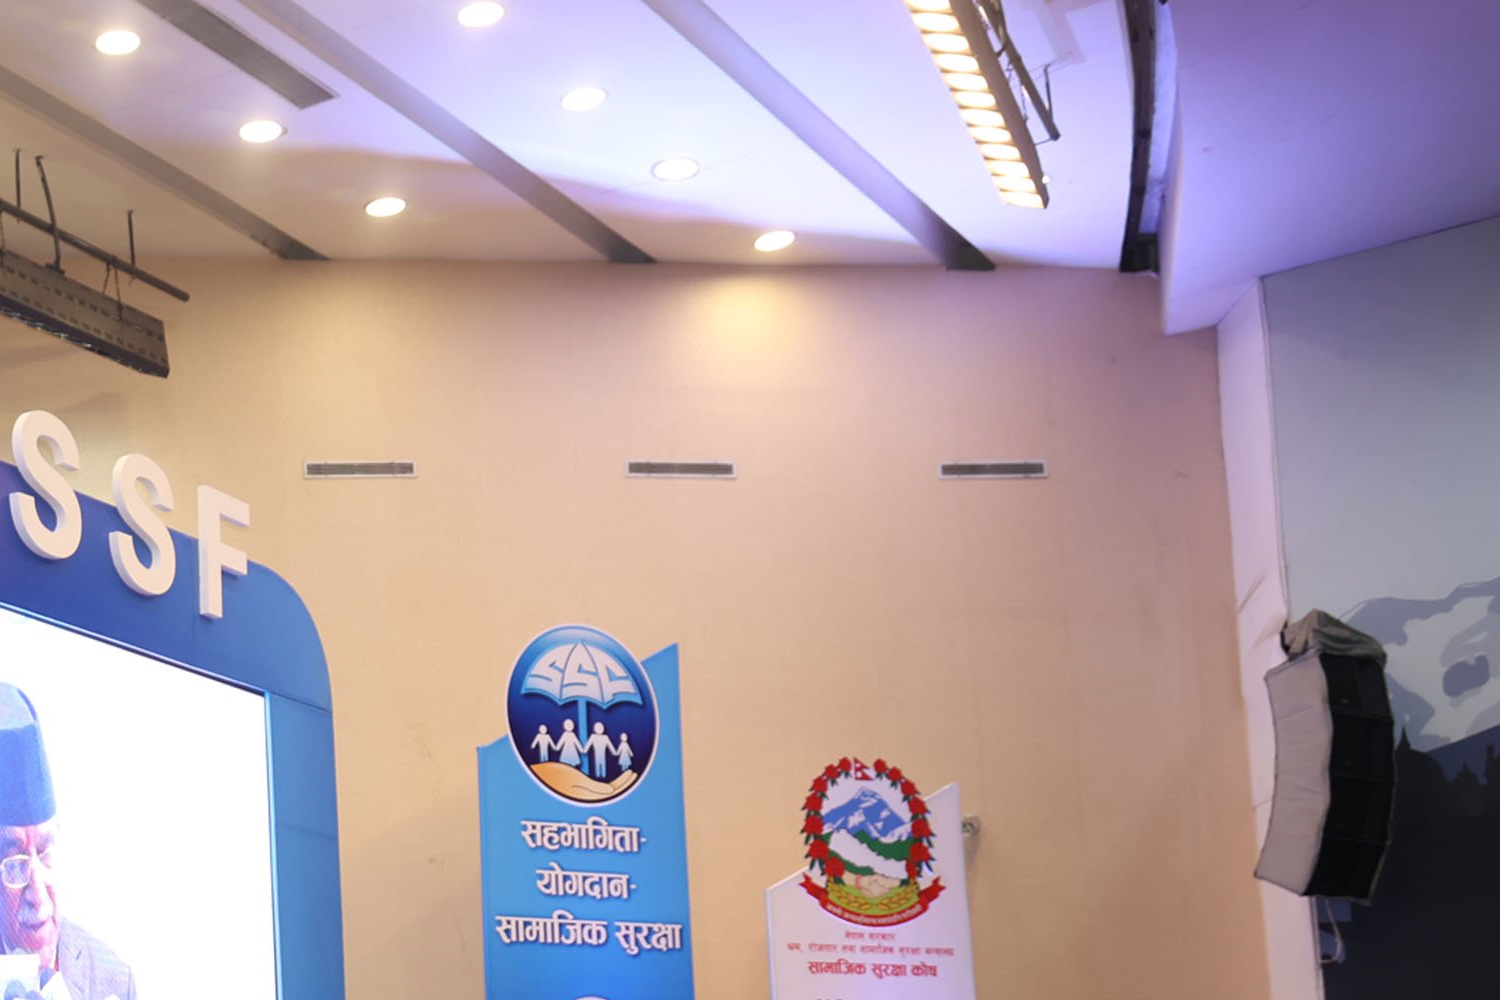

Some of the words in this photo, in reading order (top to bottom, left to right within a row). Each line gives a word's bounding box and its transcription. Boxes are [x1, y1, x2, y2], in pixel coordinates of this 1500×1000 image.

[520, 816, 648, 853] सहभागिता-
[535, 862, 637, 900] योगदान-
[495, 909, 608, 946] सामाजिक
[614, 920, 683, 956] सुरक्षा
[808, 958, 867, 976] सामाजिक
[872, 962, 908, 979] सुरक्षा
[911, 961, 938, 978] कोष
